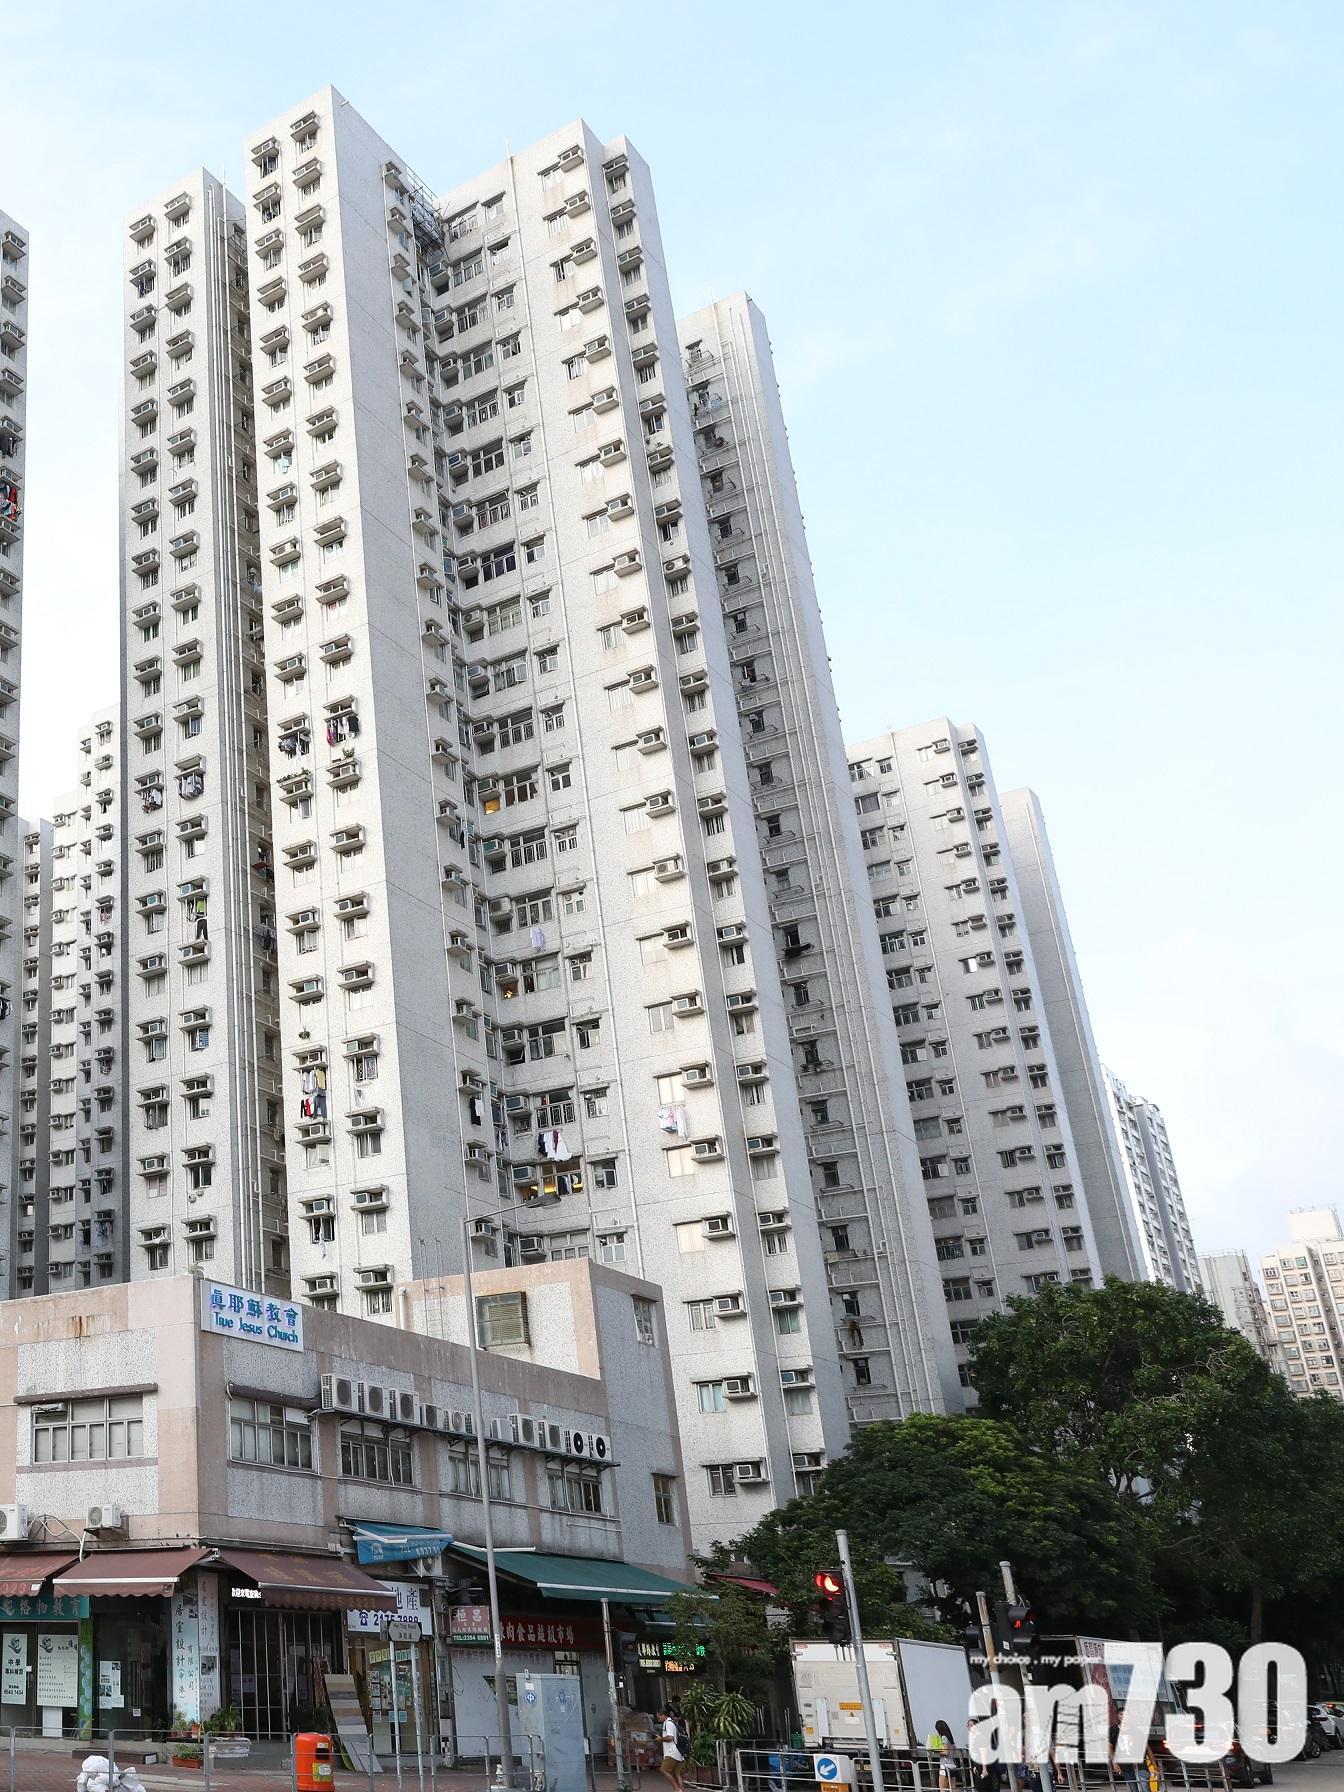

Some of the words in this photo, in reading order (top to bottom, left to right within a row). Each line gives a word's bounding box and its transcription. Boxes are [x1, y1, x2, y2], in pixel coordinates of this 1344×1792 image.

[213, 1312, 233, 1328] True
[239, 1317, 262, 1335] Jesus
[267, 1325, 298, 1343] Church
